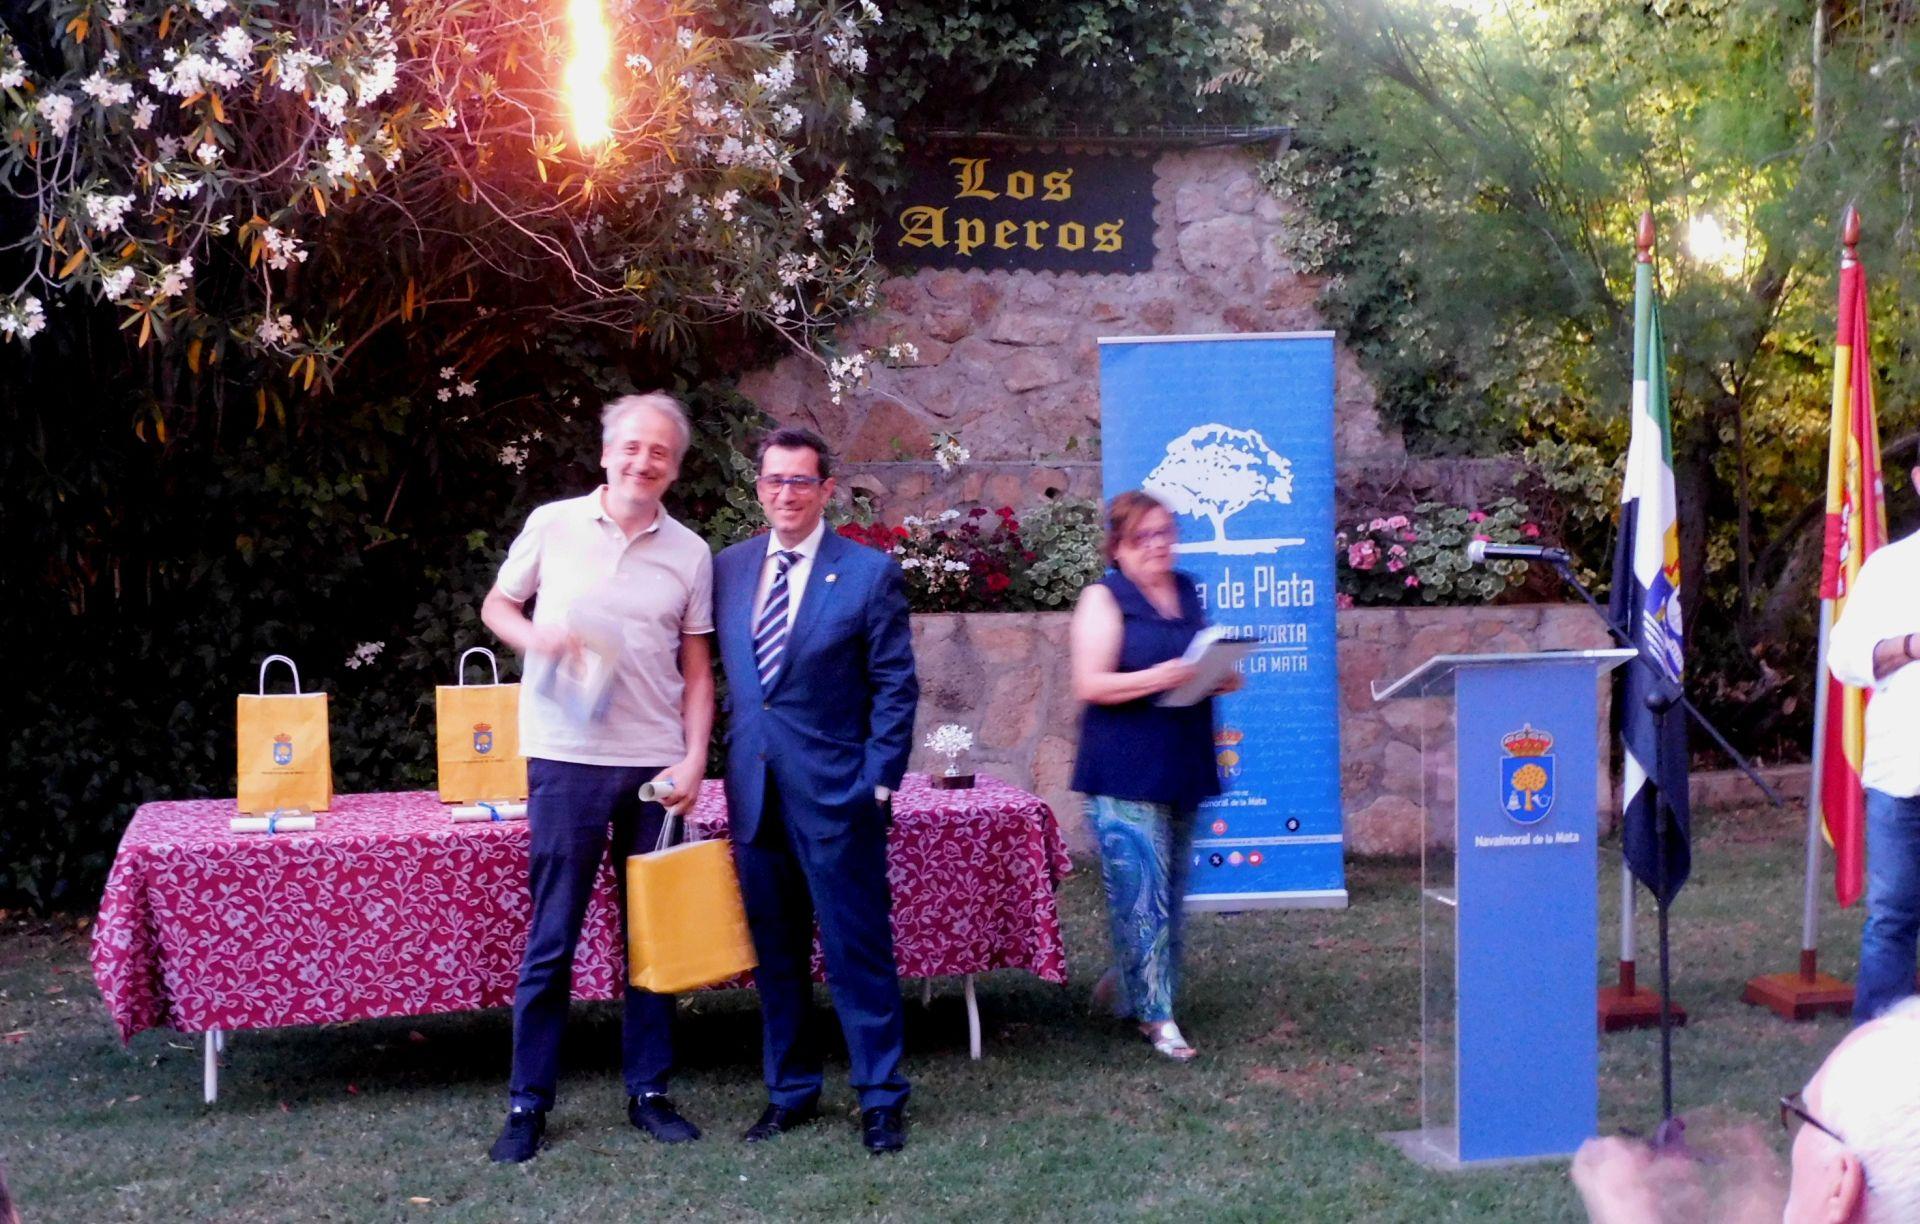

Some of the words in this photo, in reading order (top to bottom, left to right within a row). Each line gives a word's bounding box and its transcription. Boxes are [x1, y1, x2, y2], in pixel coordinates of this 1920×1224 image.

[948, 157, 1074, 201] Los
[898, 205, 1125, 257] Aperos
[1217, 566, 1245, 609] de
[1254, 566, 1314, 608] Plata
[1259, 623, 1307, 644] CORTA
[1250, 656, 1267, 673] LA
[1271, 655, 1308, 672] MATA
[1474, 833, 1531, 847] Navalmoral
[1533, 834, 1544, 844] de
[1545, 834, 1554, 844] la
[1555, 832, 1580, 843] Mata
